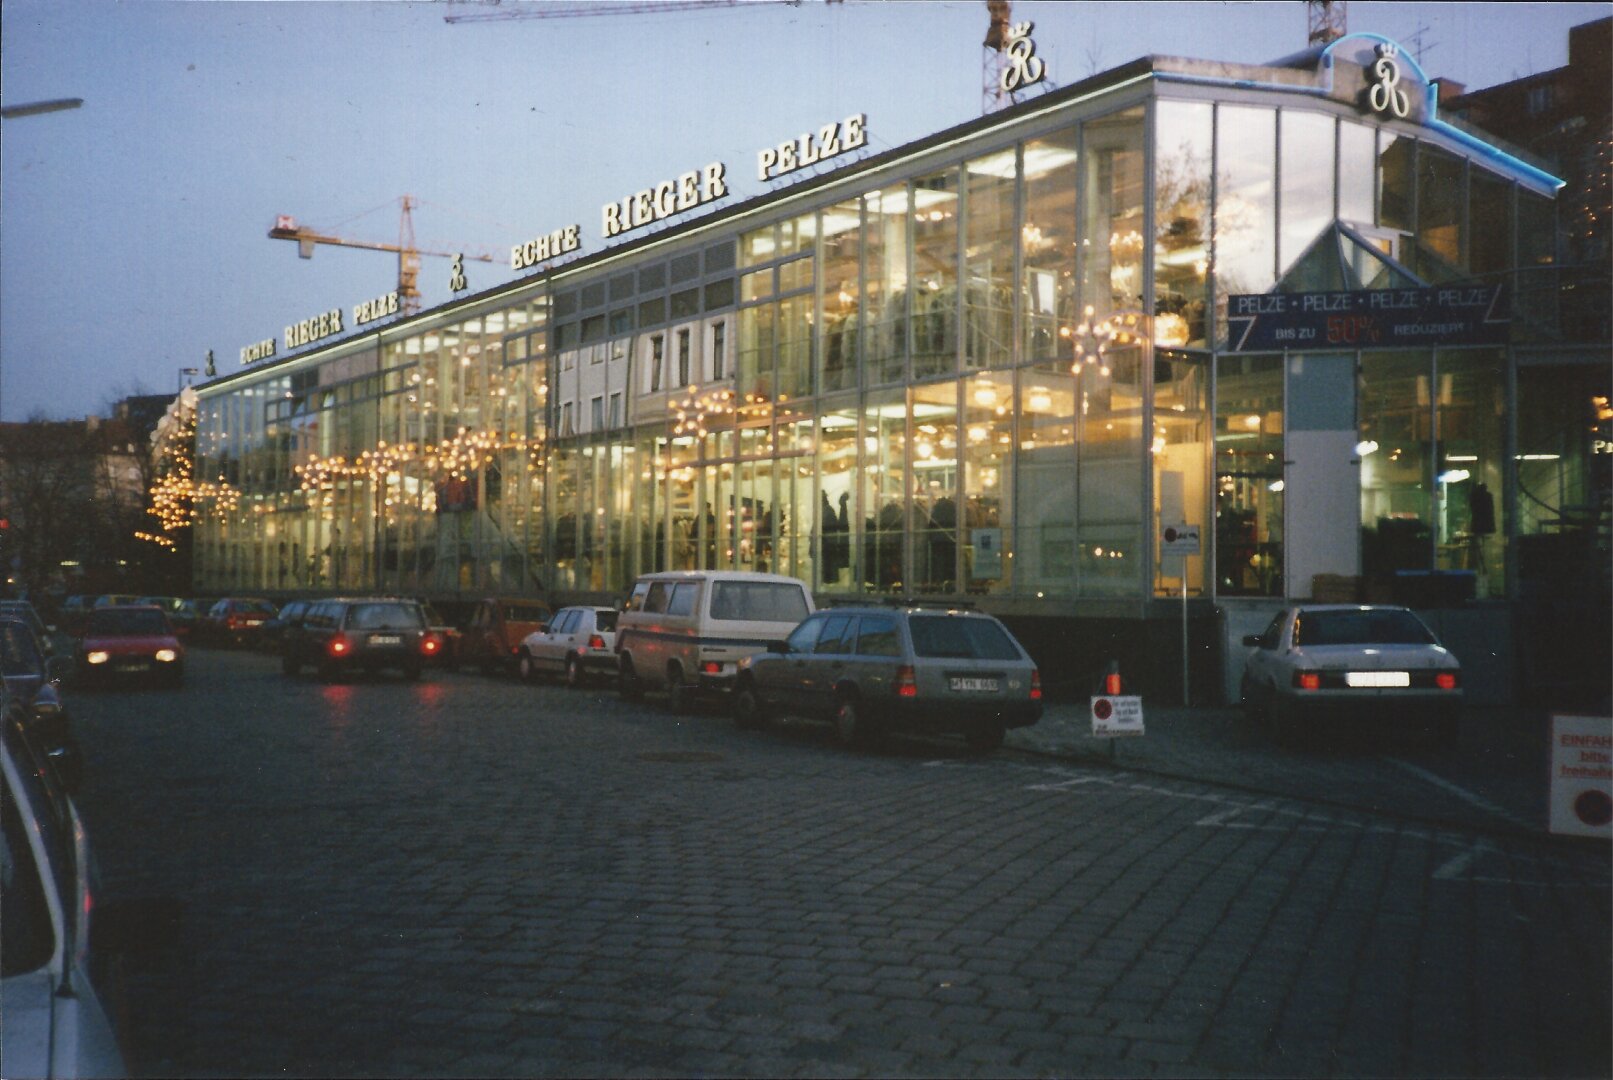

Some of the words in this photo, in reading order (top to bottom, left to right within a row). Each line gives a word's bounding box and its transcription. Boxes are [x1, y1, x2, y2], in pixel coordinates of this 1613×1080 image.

[510, 224, 580, 270] ECHTE
[601, 161, 730, 238] RIEGER
[757, 113, 868, 181] PELZE
[1238, 295, 1286, 313] PELZE
[1303, 294, 1350, 311] PELZE
[1370, 291, 1419, 308] PELZE
[1438, 289, 1488, 306] PELZE
[240, 338, 276, 364] ECHTE
[284, 308, 344, 348] RIEGER
[353, 291, 400, 325] PELZE
[1275, 328, 1296, 340] BIS
[1299, 328, 1316, 339] ZU
